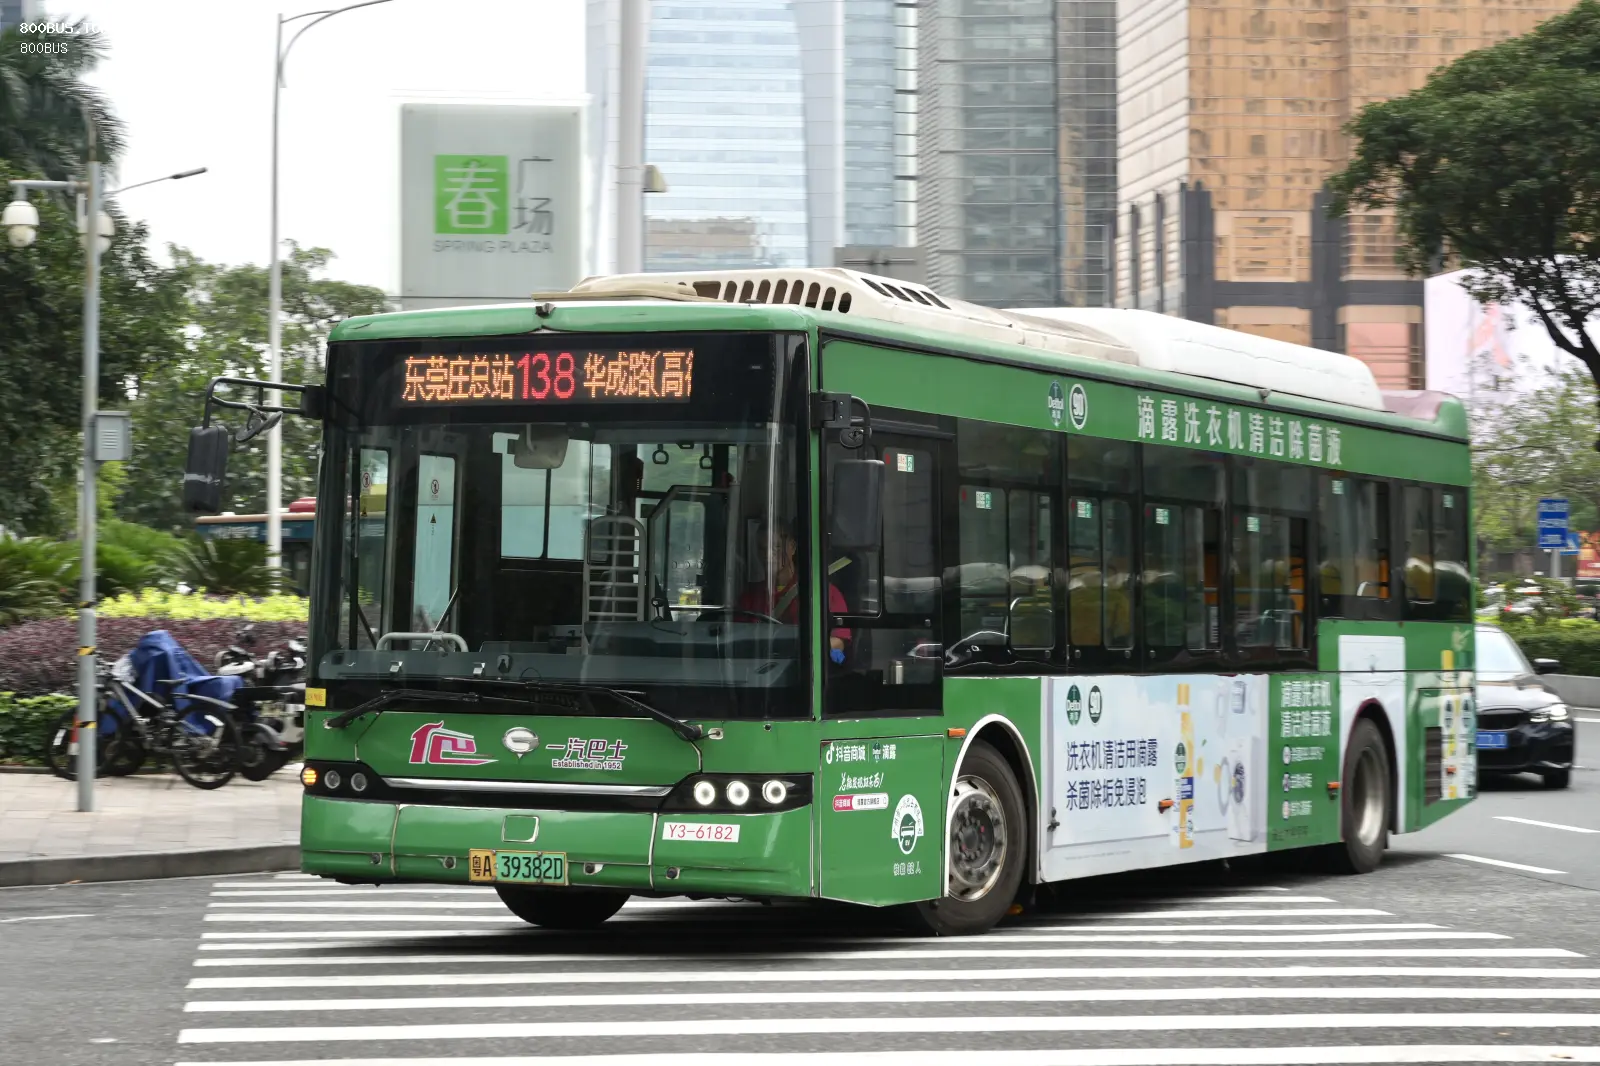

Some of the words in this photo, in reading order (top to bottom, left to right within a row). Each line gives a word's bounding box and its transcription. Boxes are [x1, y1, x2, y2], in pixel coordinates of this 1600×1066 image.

[433, 239, 496, 253] SPRING
[499, 240, 554, 253] PLAZA
[401, 354, 514, 401] 东莞庄总站
[516, 352, 576, 400] 138
[1137, 395, 1342, 465] 滴露洗衣机清洁除菌液
[546, 737, 628, 761] 一汽巴士
[836, 745, 866, 762] 抖音商城
[1066, 738, 1158, 771] 洗衣机清洁用滴露
[552, 759, 593, 769] Established
[594, 760, 602, 770] in
[603, 761, 622, 770] 1952
[1066, 776, 1147, 811] 杀菌除垢免浸泡
[669, 824, 733, 840] Y3-6182
